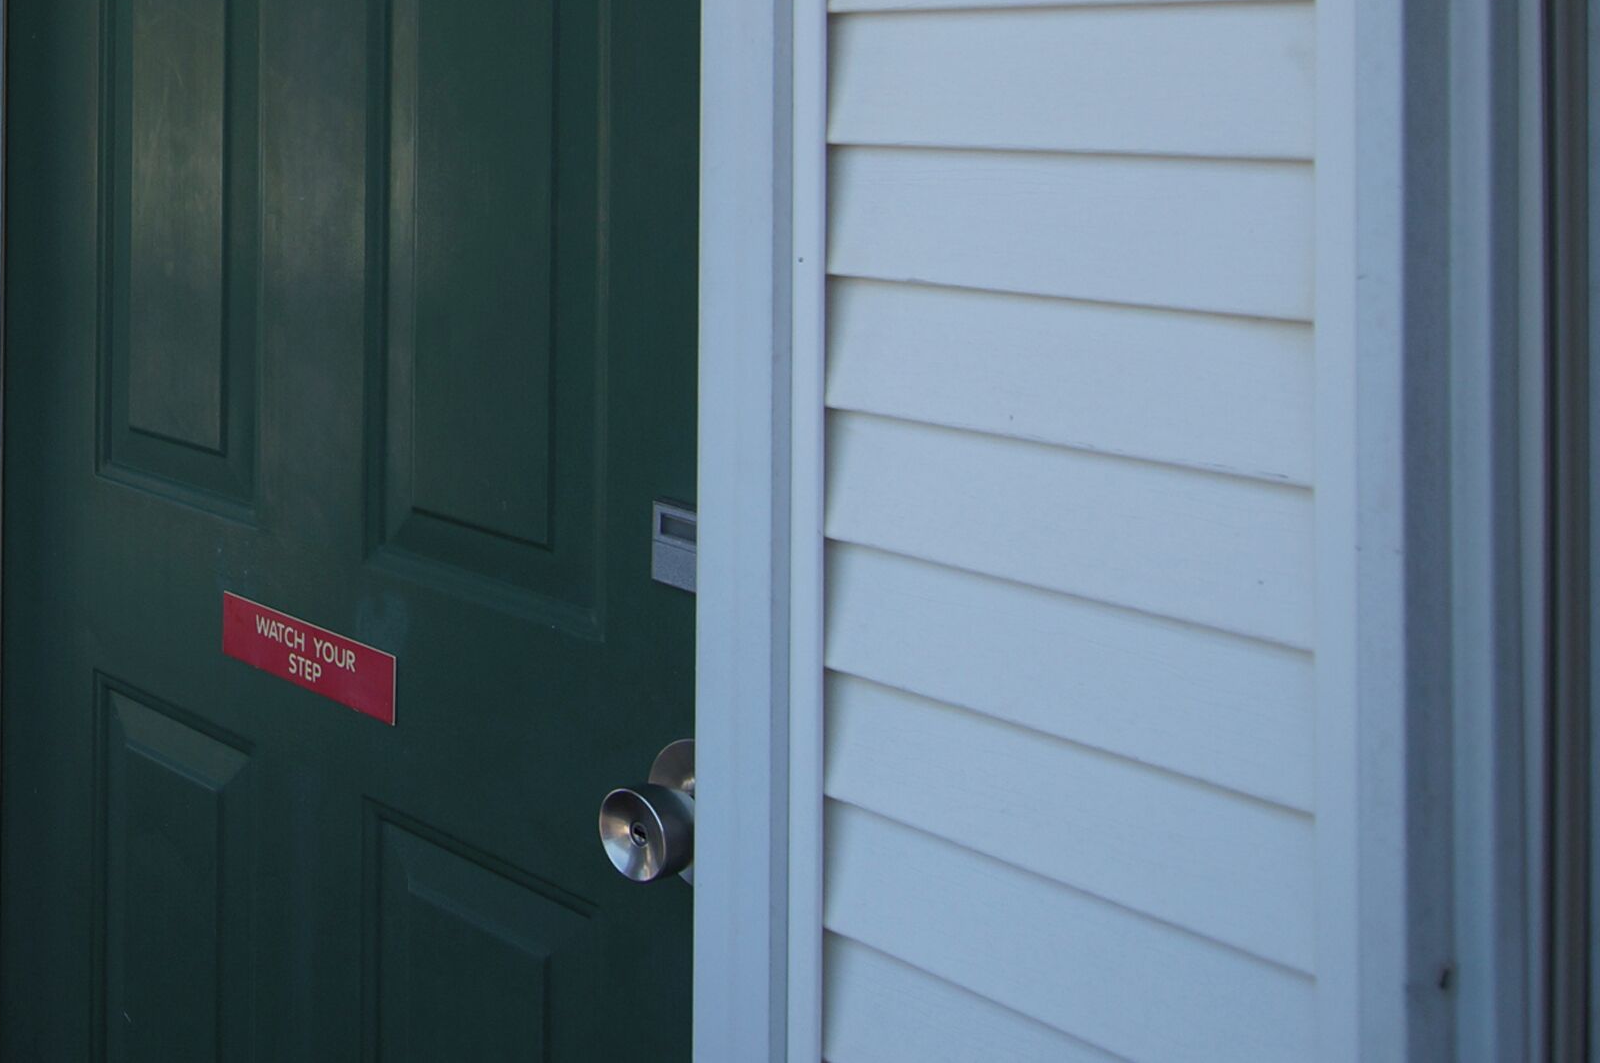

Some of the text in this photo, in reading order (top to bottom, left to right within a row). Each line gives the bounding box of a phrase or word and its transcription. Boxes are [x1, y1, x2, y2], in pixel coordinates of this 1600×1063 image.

[256, 614, 356, 673] WATCH YOUR
[288, 653, 322, 682] STEP
